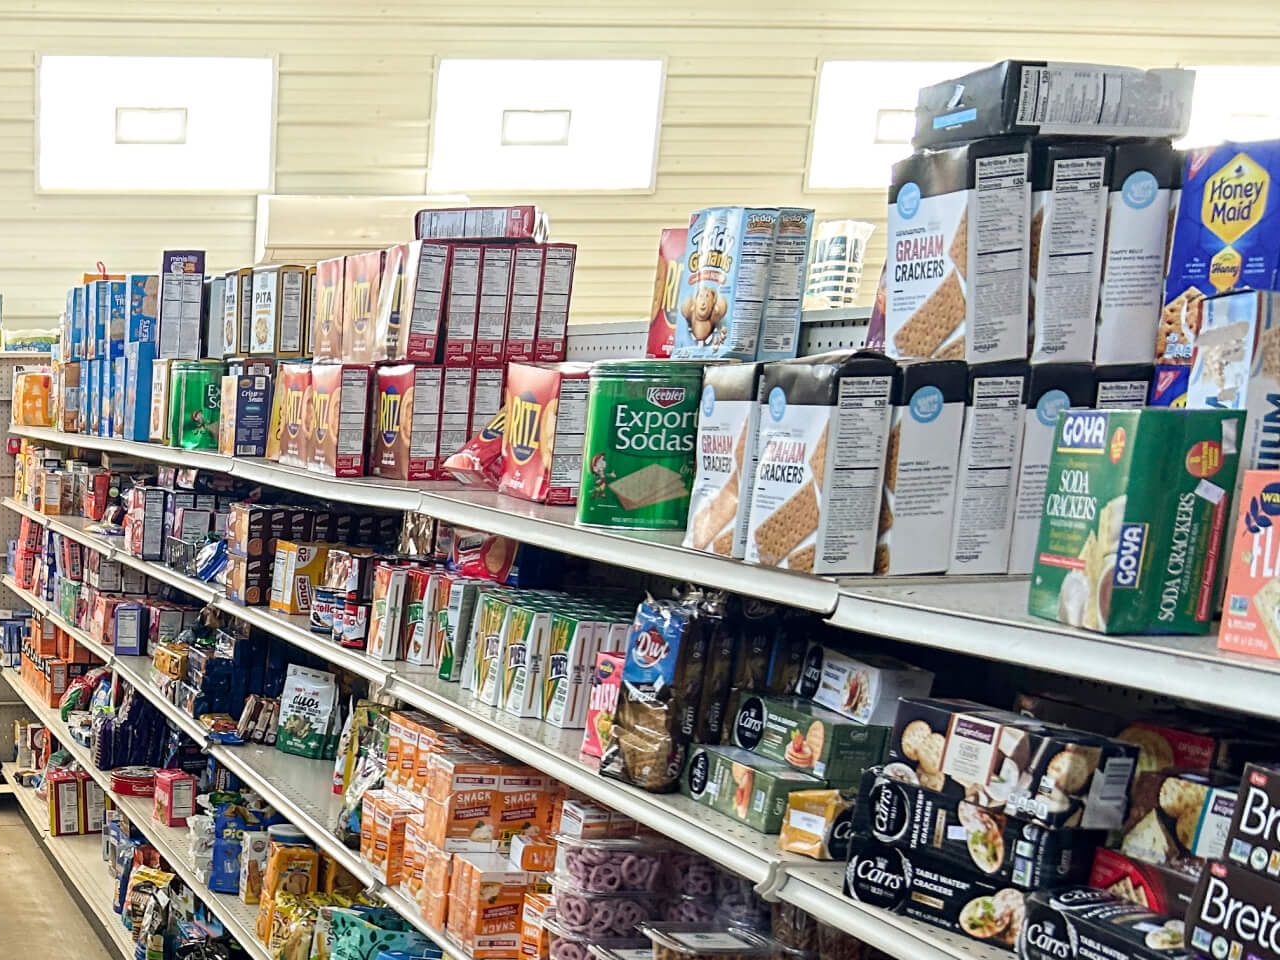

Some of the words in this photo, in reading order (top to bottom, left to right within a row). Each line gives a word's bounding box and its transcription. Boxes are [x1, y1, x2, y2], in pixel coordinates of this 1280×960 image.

[979, 158, 1007, 167] Nutrition
[1012, 177, 1024, 185] 130
[1209, 178, 1264, 204] Honey
[1211, 201, 1252, 225] Maid
[896, 235, 944, 262] GRAHAM
[895, 260, 944, 283] CRACKERS
[255, 292, 272, 304] PITA
[648, 387, 685, 401] Keebler
[380, 391, 400, 432] RITZ
[616, 405, 700, 429] Export
[510, 401, 541, 448] RITZ
[1063, 415, 1105, 446] GOYA
[615, 428, 694, 451] Sodas
[701, 434, 733, 456] GRAHAM
[763, 440, 806, 464] GRAHAM
[703, 455, 732, 475] CRACKERS
[759, 462, 803, 484] CRACKERS
[1060, 470, 1089, 494] SODA
[1047, 494, 1097, 520] CRACKERS
[1168, 492, 1196, 577] CRACKERS
[1117, 527, 1143, 585] GOYA
[299, 577, 310, 611] Lance
[1158, 576, 1180, 622] SODA
[1177, 742, 1210, 756] original
[457, 791, 492, 803] SNACK
[504, 792, 537, 804] SNACK
[920, 801, 933, 844] CRACKERS
[915, 867, 939, 882] TABLE
[913, 879, 953, 897] CRACKERS
[1080, 935, 1101, 951] TABLE
